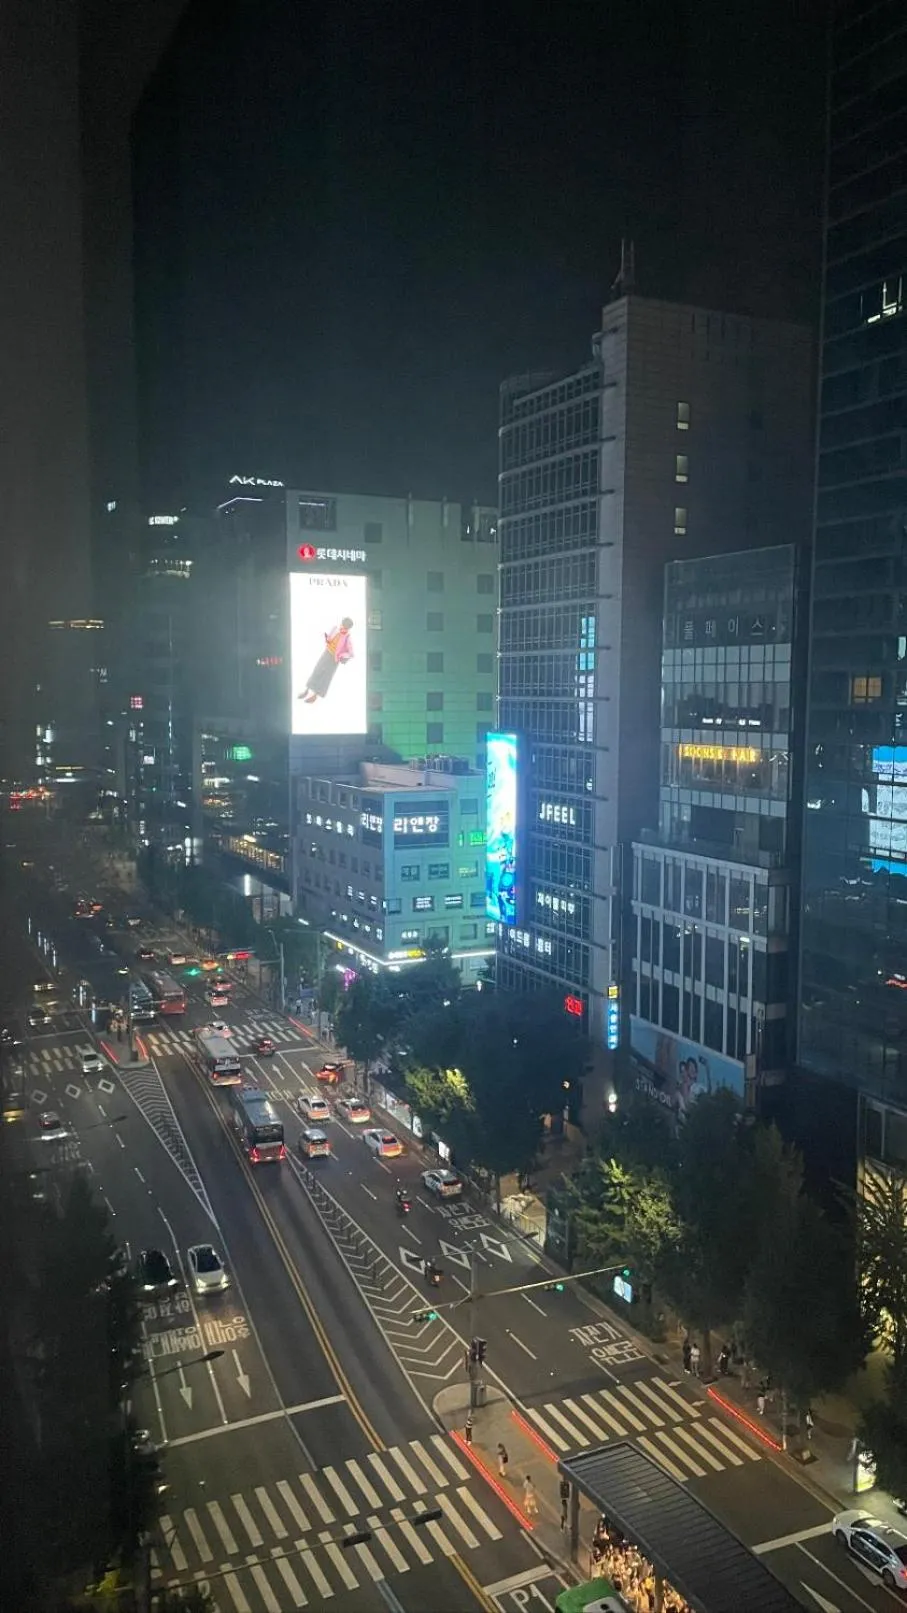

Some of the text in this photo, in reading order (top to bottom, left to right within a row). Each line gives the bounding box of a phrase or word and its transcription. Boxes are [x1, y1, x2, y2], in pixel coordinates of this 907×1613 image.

[229, 475, 284, 487] AK PLAZA
[316, 547, 366, 562] 롯데시네마
[309, 577, 349, 587] PRADA
[539, 802, 576, 825] JFEEL
